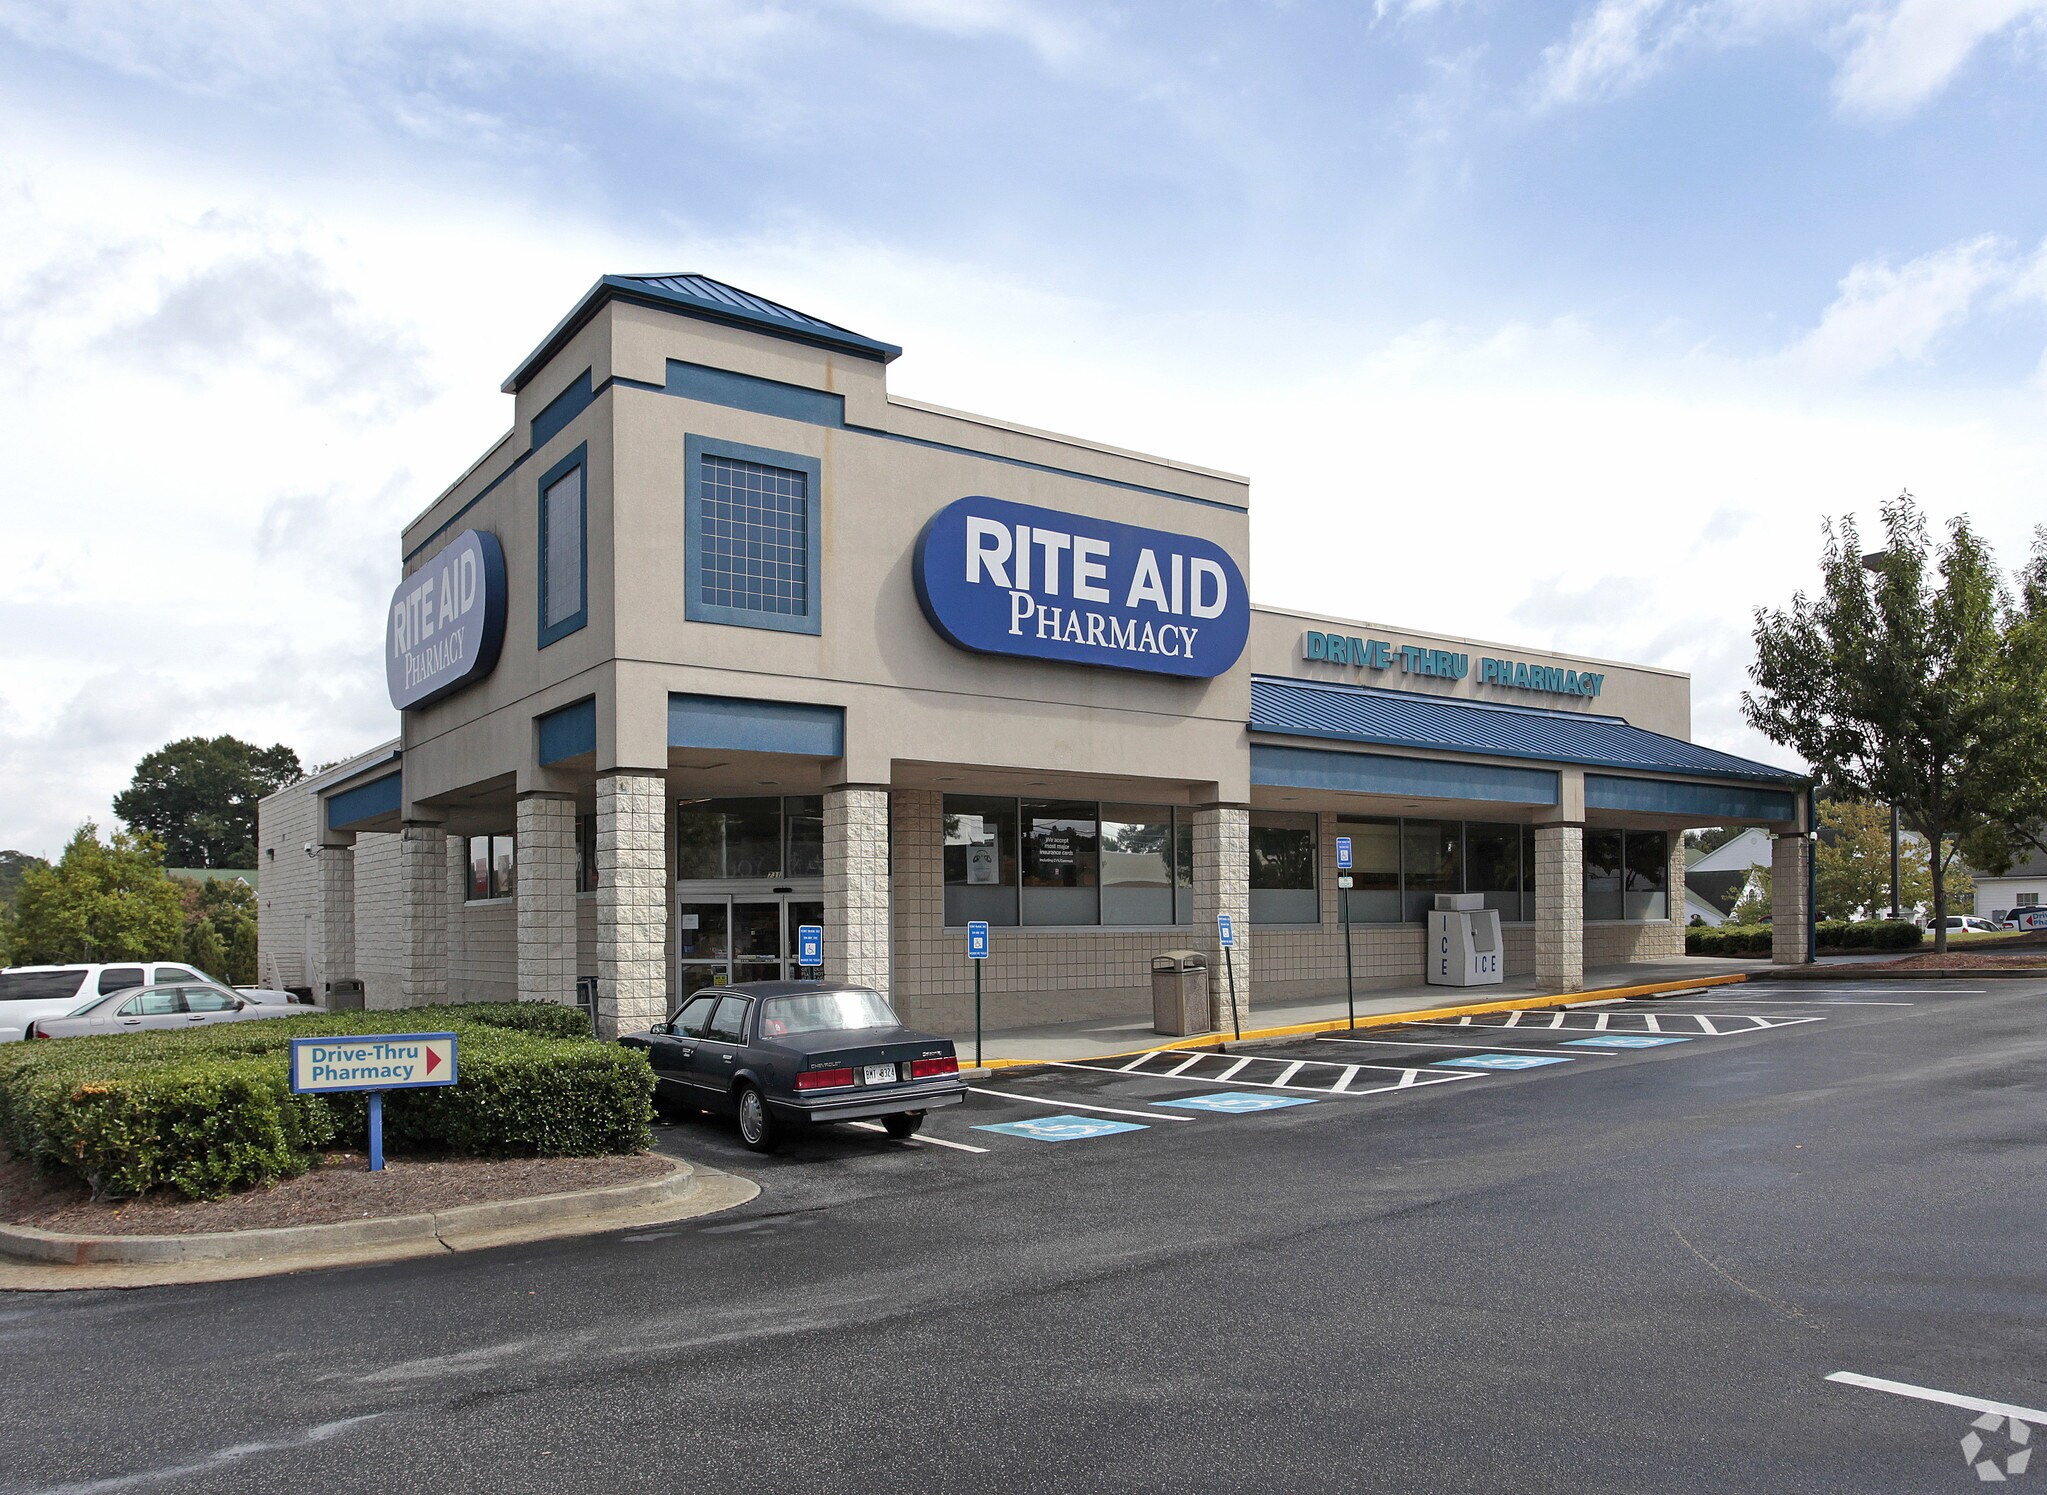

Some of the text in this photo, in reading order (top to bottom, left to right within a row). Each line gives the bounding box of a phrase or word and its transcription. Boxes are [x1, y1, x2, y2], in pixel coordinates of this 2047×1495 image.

[965, 515, 1229, 620] RITE AID
[393, 548, 477, 659] RITE AID
[1008, 590, 1199, 659] PHARMACY
[1303, 630, 1605, 698] DRIVE-THRU PHARMACY
[1474, 955, 1496, 974] ICE
[312, 1044, 418, 1063] Drive-Thru
[312, 1065, 414, 1082] Pharmacy
